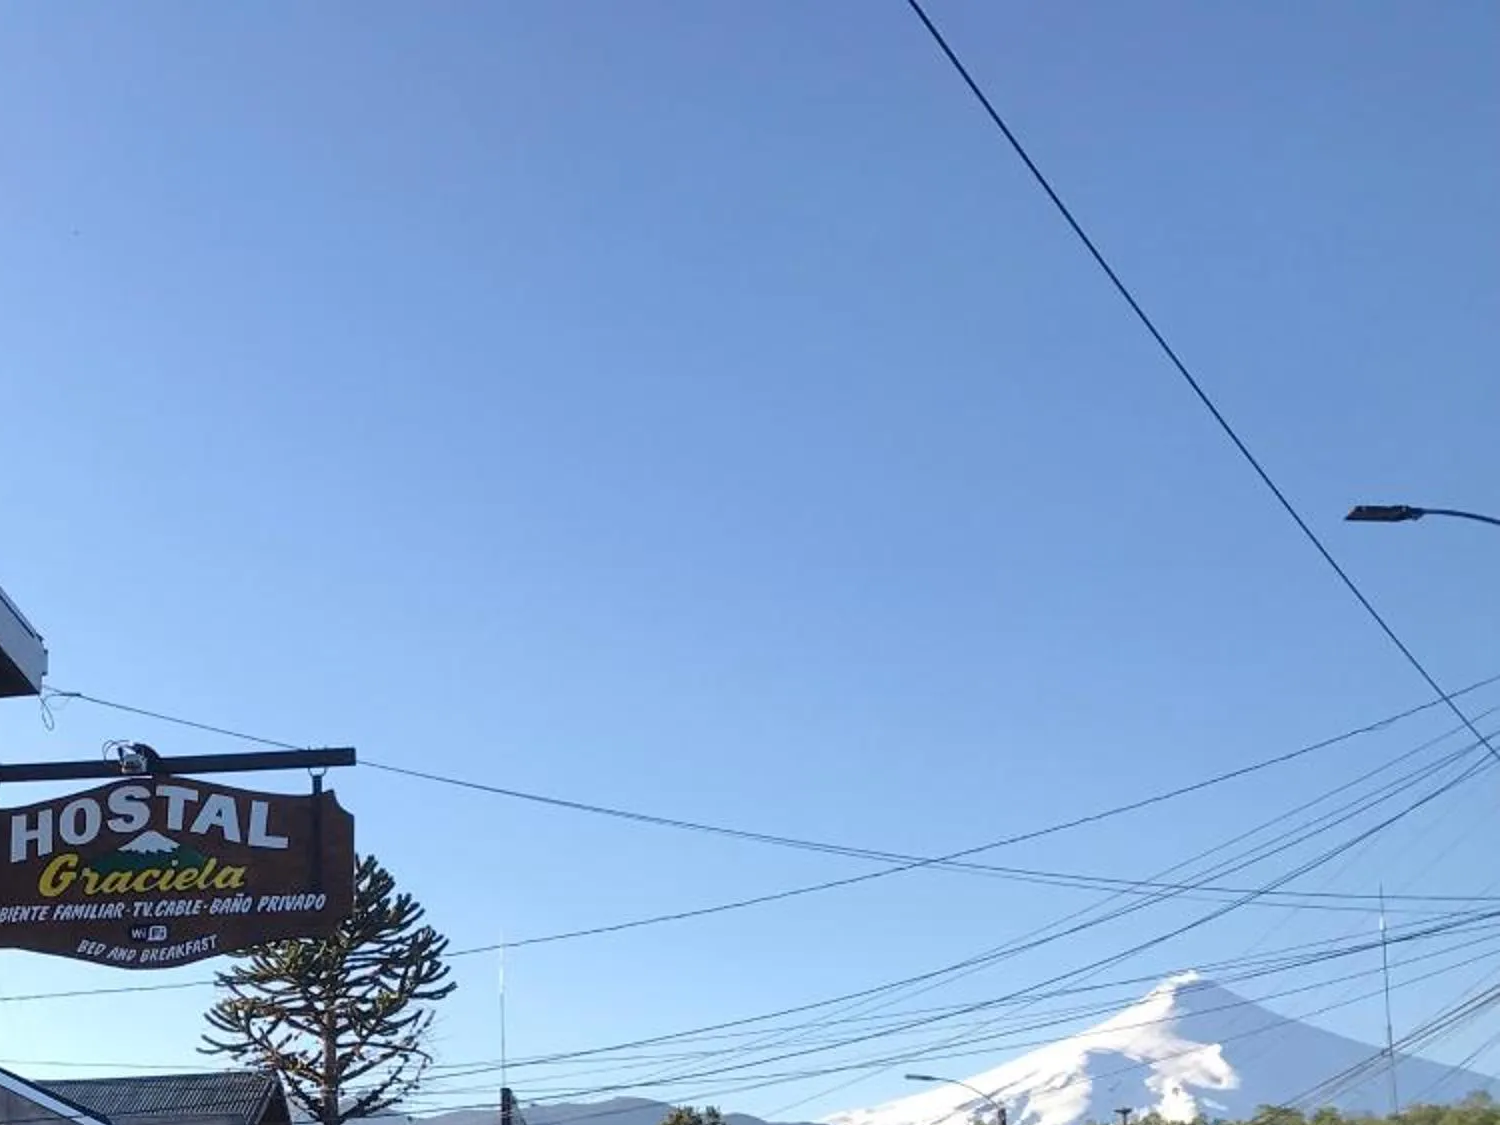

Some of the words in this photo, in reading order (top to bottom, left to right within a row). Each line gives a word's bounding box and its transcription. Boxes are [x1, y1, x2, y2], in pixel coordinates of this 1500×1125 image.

[10, 785, 289, 863] HOSTAL
[38, 854, 246, 897] Graciela
[52, 903, 124, 921] FAMILIAR
[209, 893, 251, 913] BAÑO
[257, 893, 326, 912] PRIVADO
[76, 939, 108, 956] BED
[108, 945, 137, 962] AND
[140, 934, 219, 962] BREAKFAST
